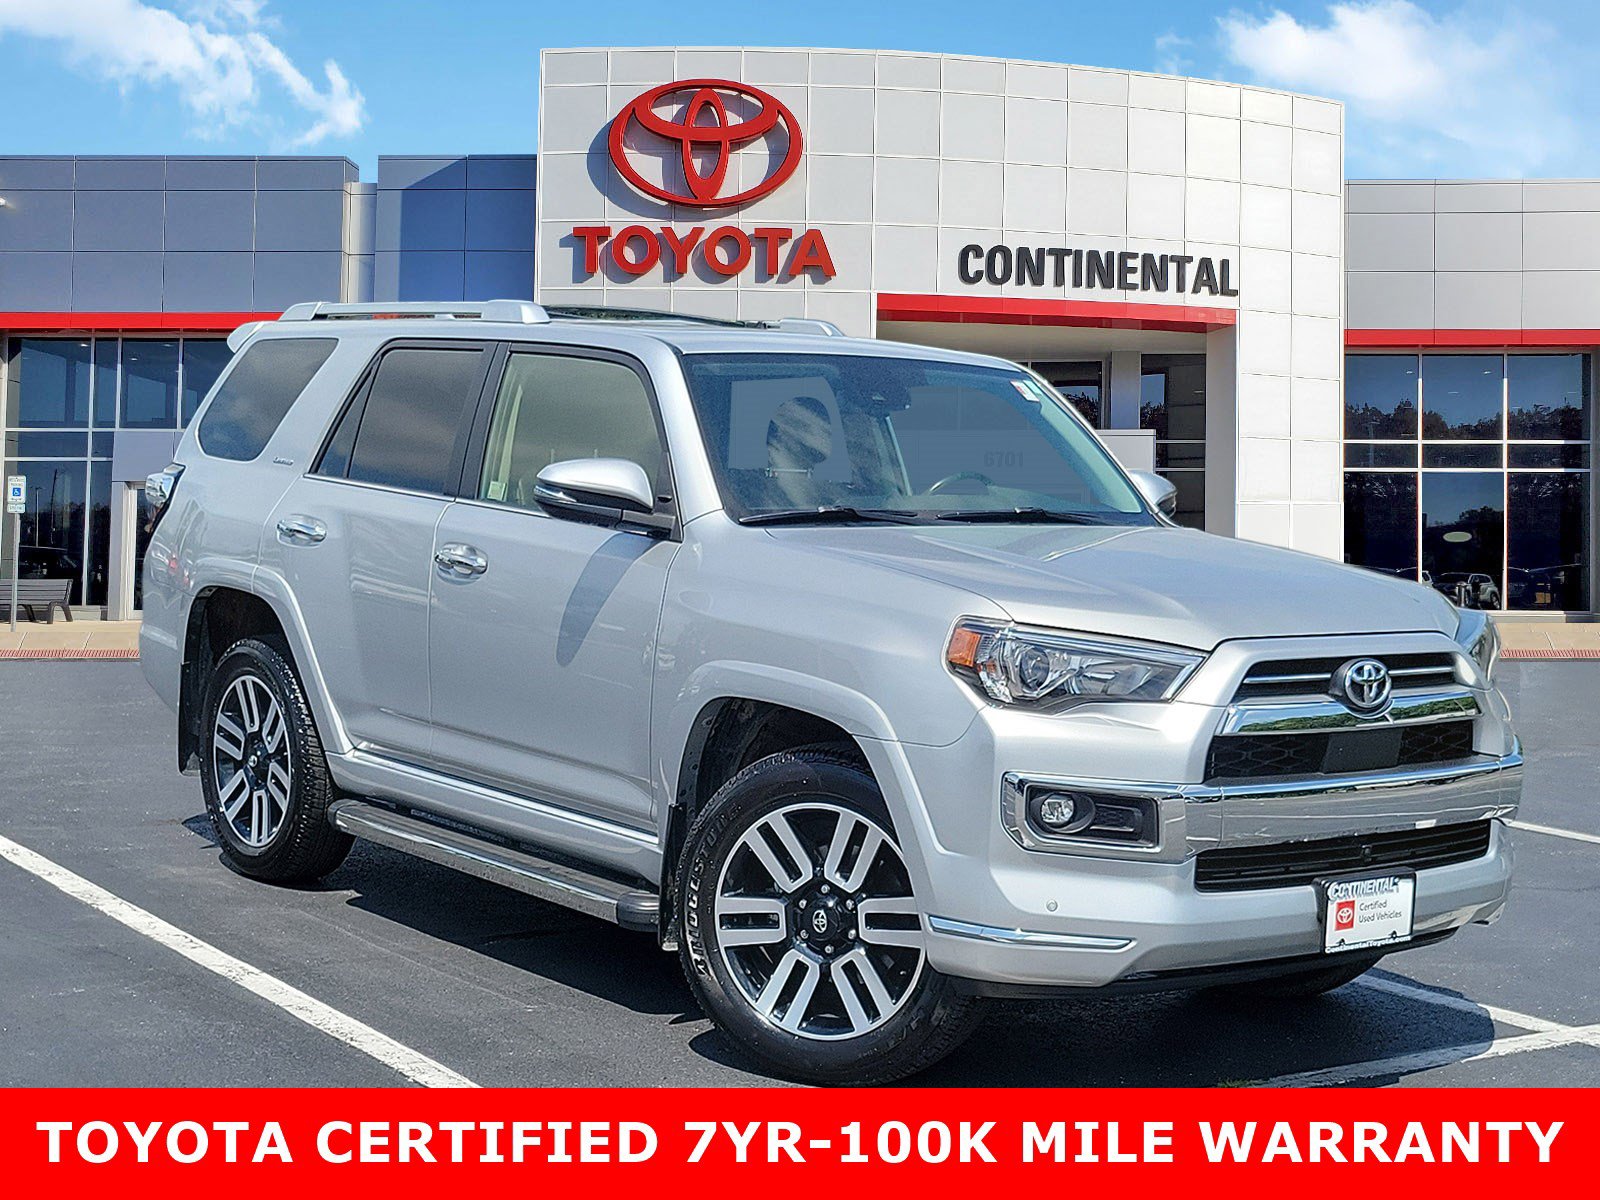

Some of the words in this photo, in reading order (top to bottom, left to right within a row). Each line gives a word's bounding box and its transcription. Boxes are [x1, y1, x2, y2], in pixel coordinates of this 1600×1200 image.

[573, 225, 836, 277] TOYOTA
[958, 244, 1239, 296] CONTINENTAL
[984, 451, 1024, 468] 6701
[1359, 900, 1388, 911] Certified
[1359, 914, 1375, 924] Used
[1376, 910, 1402, 921] Vehicles
